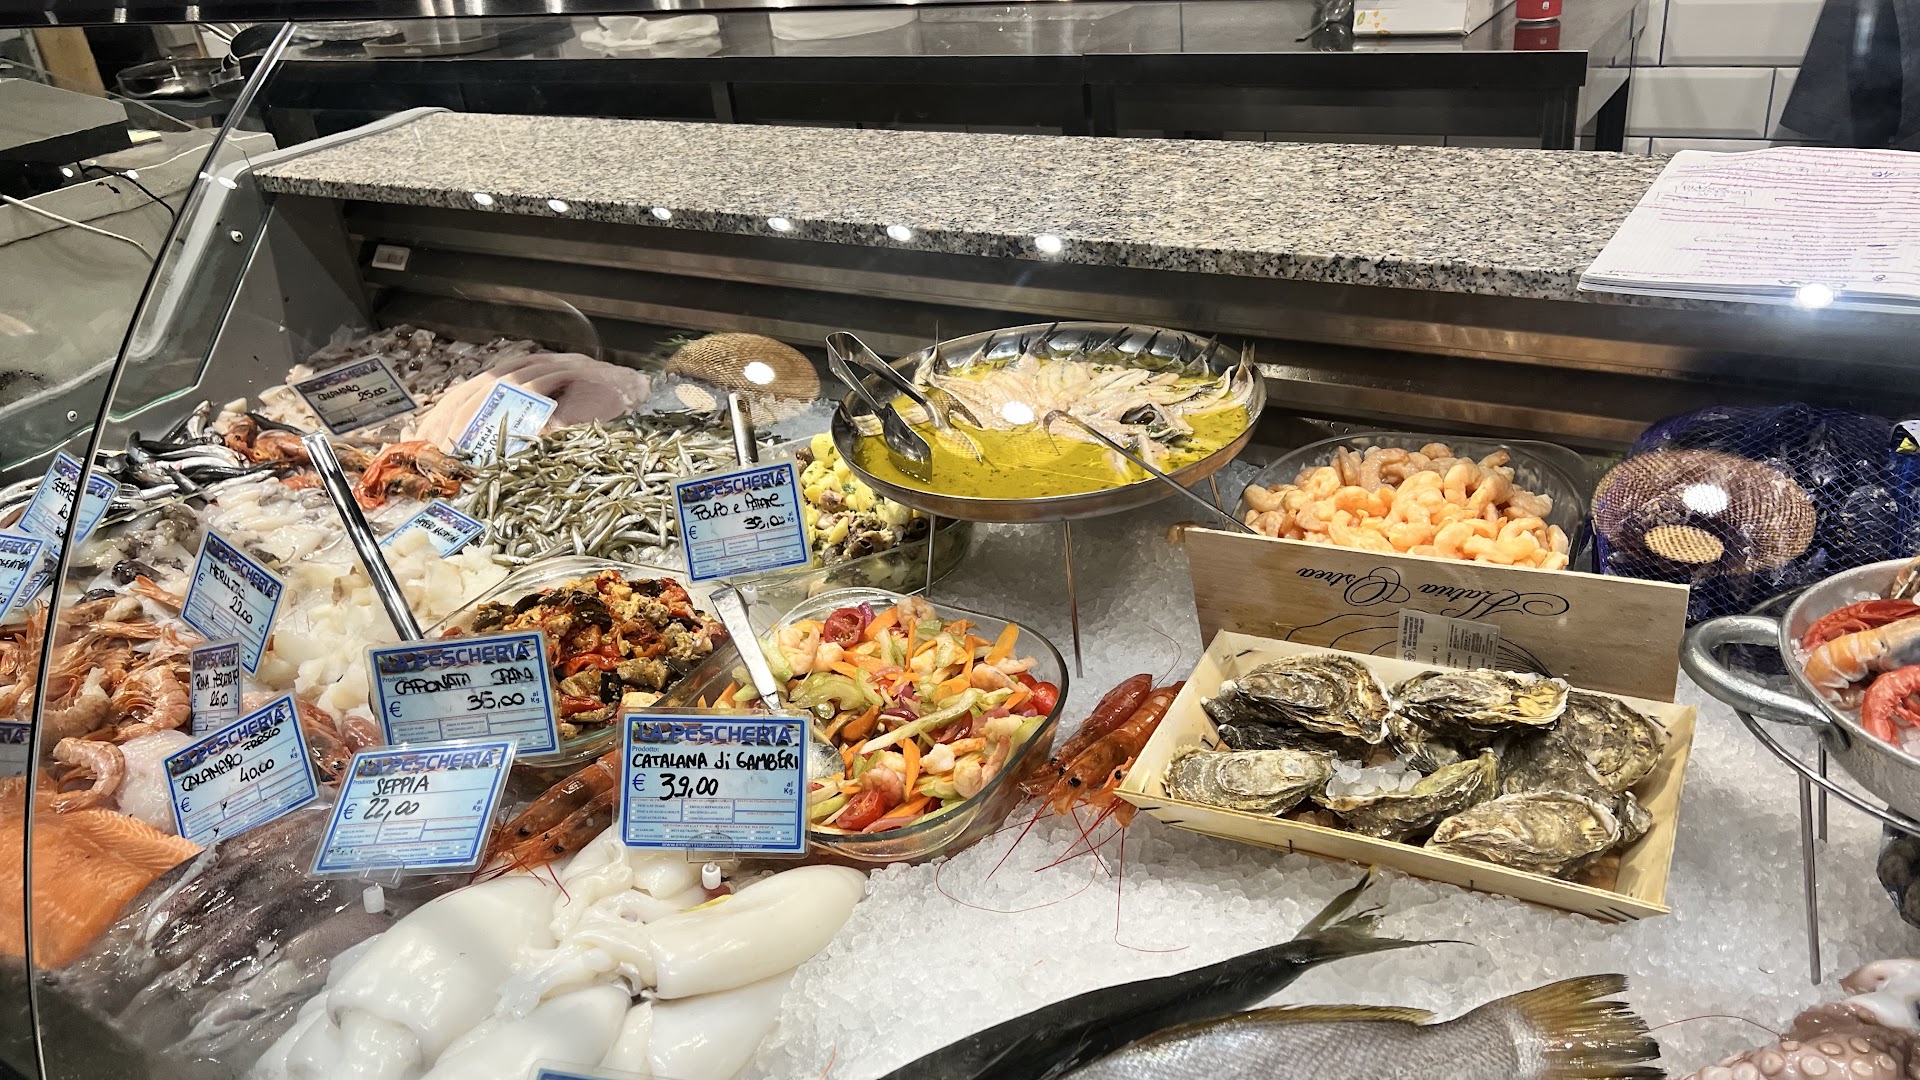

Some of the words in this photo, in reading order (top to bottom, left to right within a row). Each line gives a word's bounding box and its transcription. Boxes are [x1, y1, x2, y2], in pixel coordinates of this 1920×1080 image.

[704, 470, 786, 497] PESCHERIA
[691, 502, 728, 520] POLPO
[734, 503, 740, 513] e
[689, 525, 699, 540] €
[198, 572, 205, 587] €
[1296, 566, 1410, 606] Ostrea
[414, 642, 531, 669] PESCHERIA
[389, 701, 403, 717] €
[467, 691, 525, 711] 35,00
[195, 707, 286, 761] PESCHERIA
[638, 725, 664, 742] LA
[671, 725, 793, 743] PESCHERIA
[181, 753, 243, 791] CALAMARO
[241, 727, 281, 751] FRESCO
[361, 759, 385, 776] LA
[389, 750, 493, 773] PESCHERIA
[632, 751, 708, 769] CATALANA
[714, 751, 730, 769] di
[736, 749, 799, 771] GAMBERI
[372, 775, 429, 796] SEPPIA
[632, 773, 646, 792] €
[659, 773, 719, 800] 39,00
[783, 787, 796, 796] Kg.
[786, 780, 794, 788] al
[180, 797, 192, 813] €
[343, 803, 357, 820] €
[363, 797, 420, 822] 22,00
